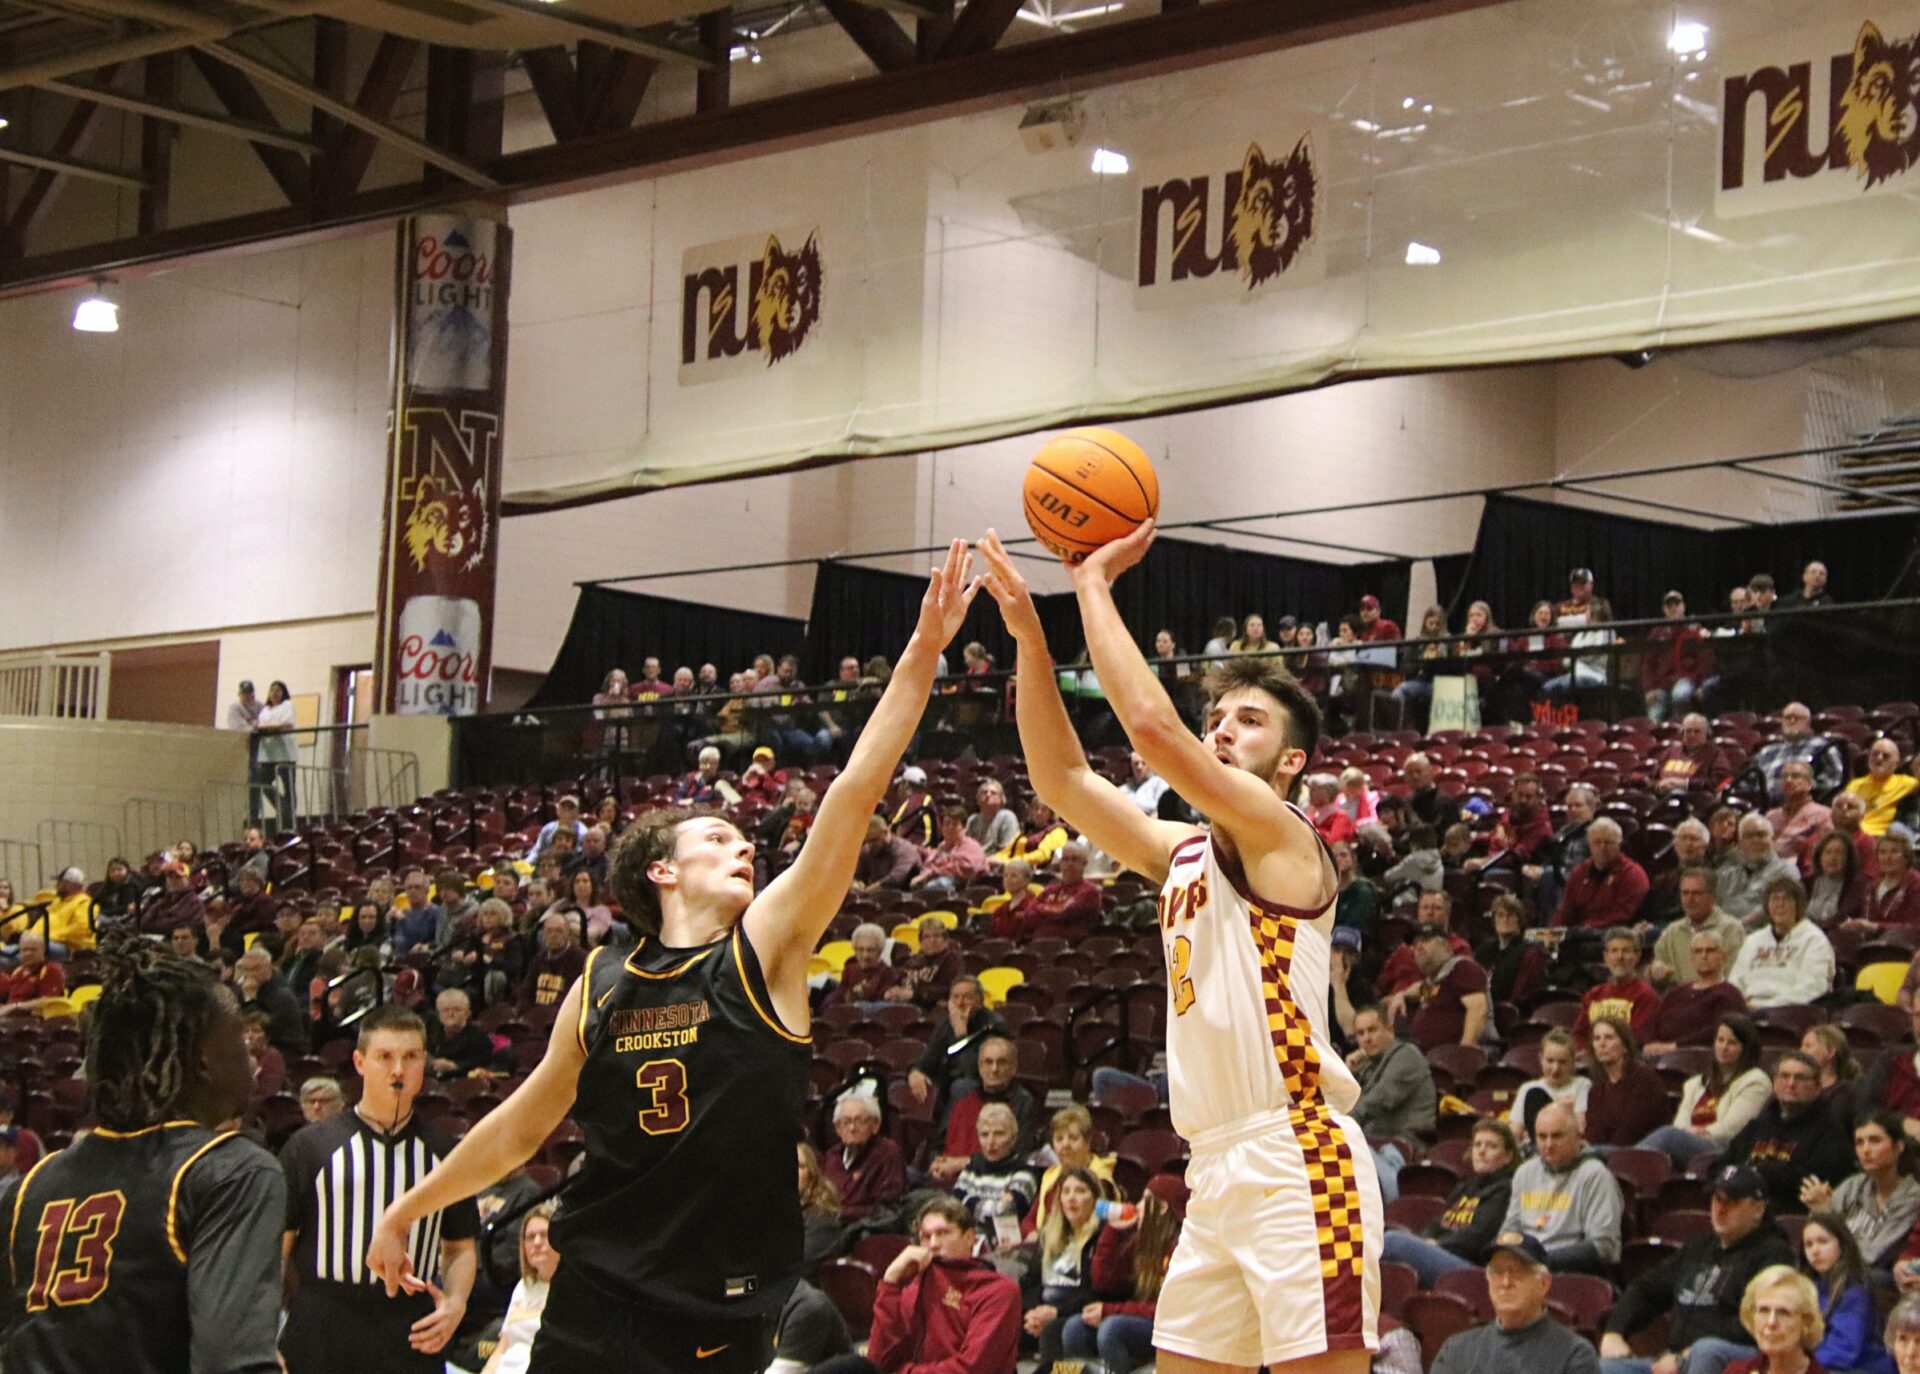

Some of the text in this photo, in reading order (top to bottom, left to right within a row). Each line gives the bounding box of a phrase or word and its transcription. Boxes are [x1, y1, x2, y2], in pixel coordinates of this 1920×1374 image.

[416, 236, 495, 284] Coor
[399, 634, 480, 683] Coor
[400, 682, 477, 709] LIGHT
[608, 999, 710, 1036] MINNESOTA
[615, 1026, 698, 1053] CROOKSTON
[636, 1058, 690, 1136] 3
[26, 1189, 127, 1313] 13
